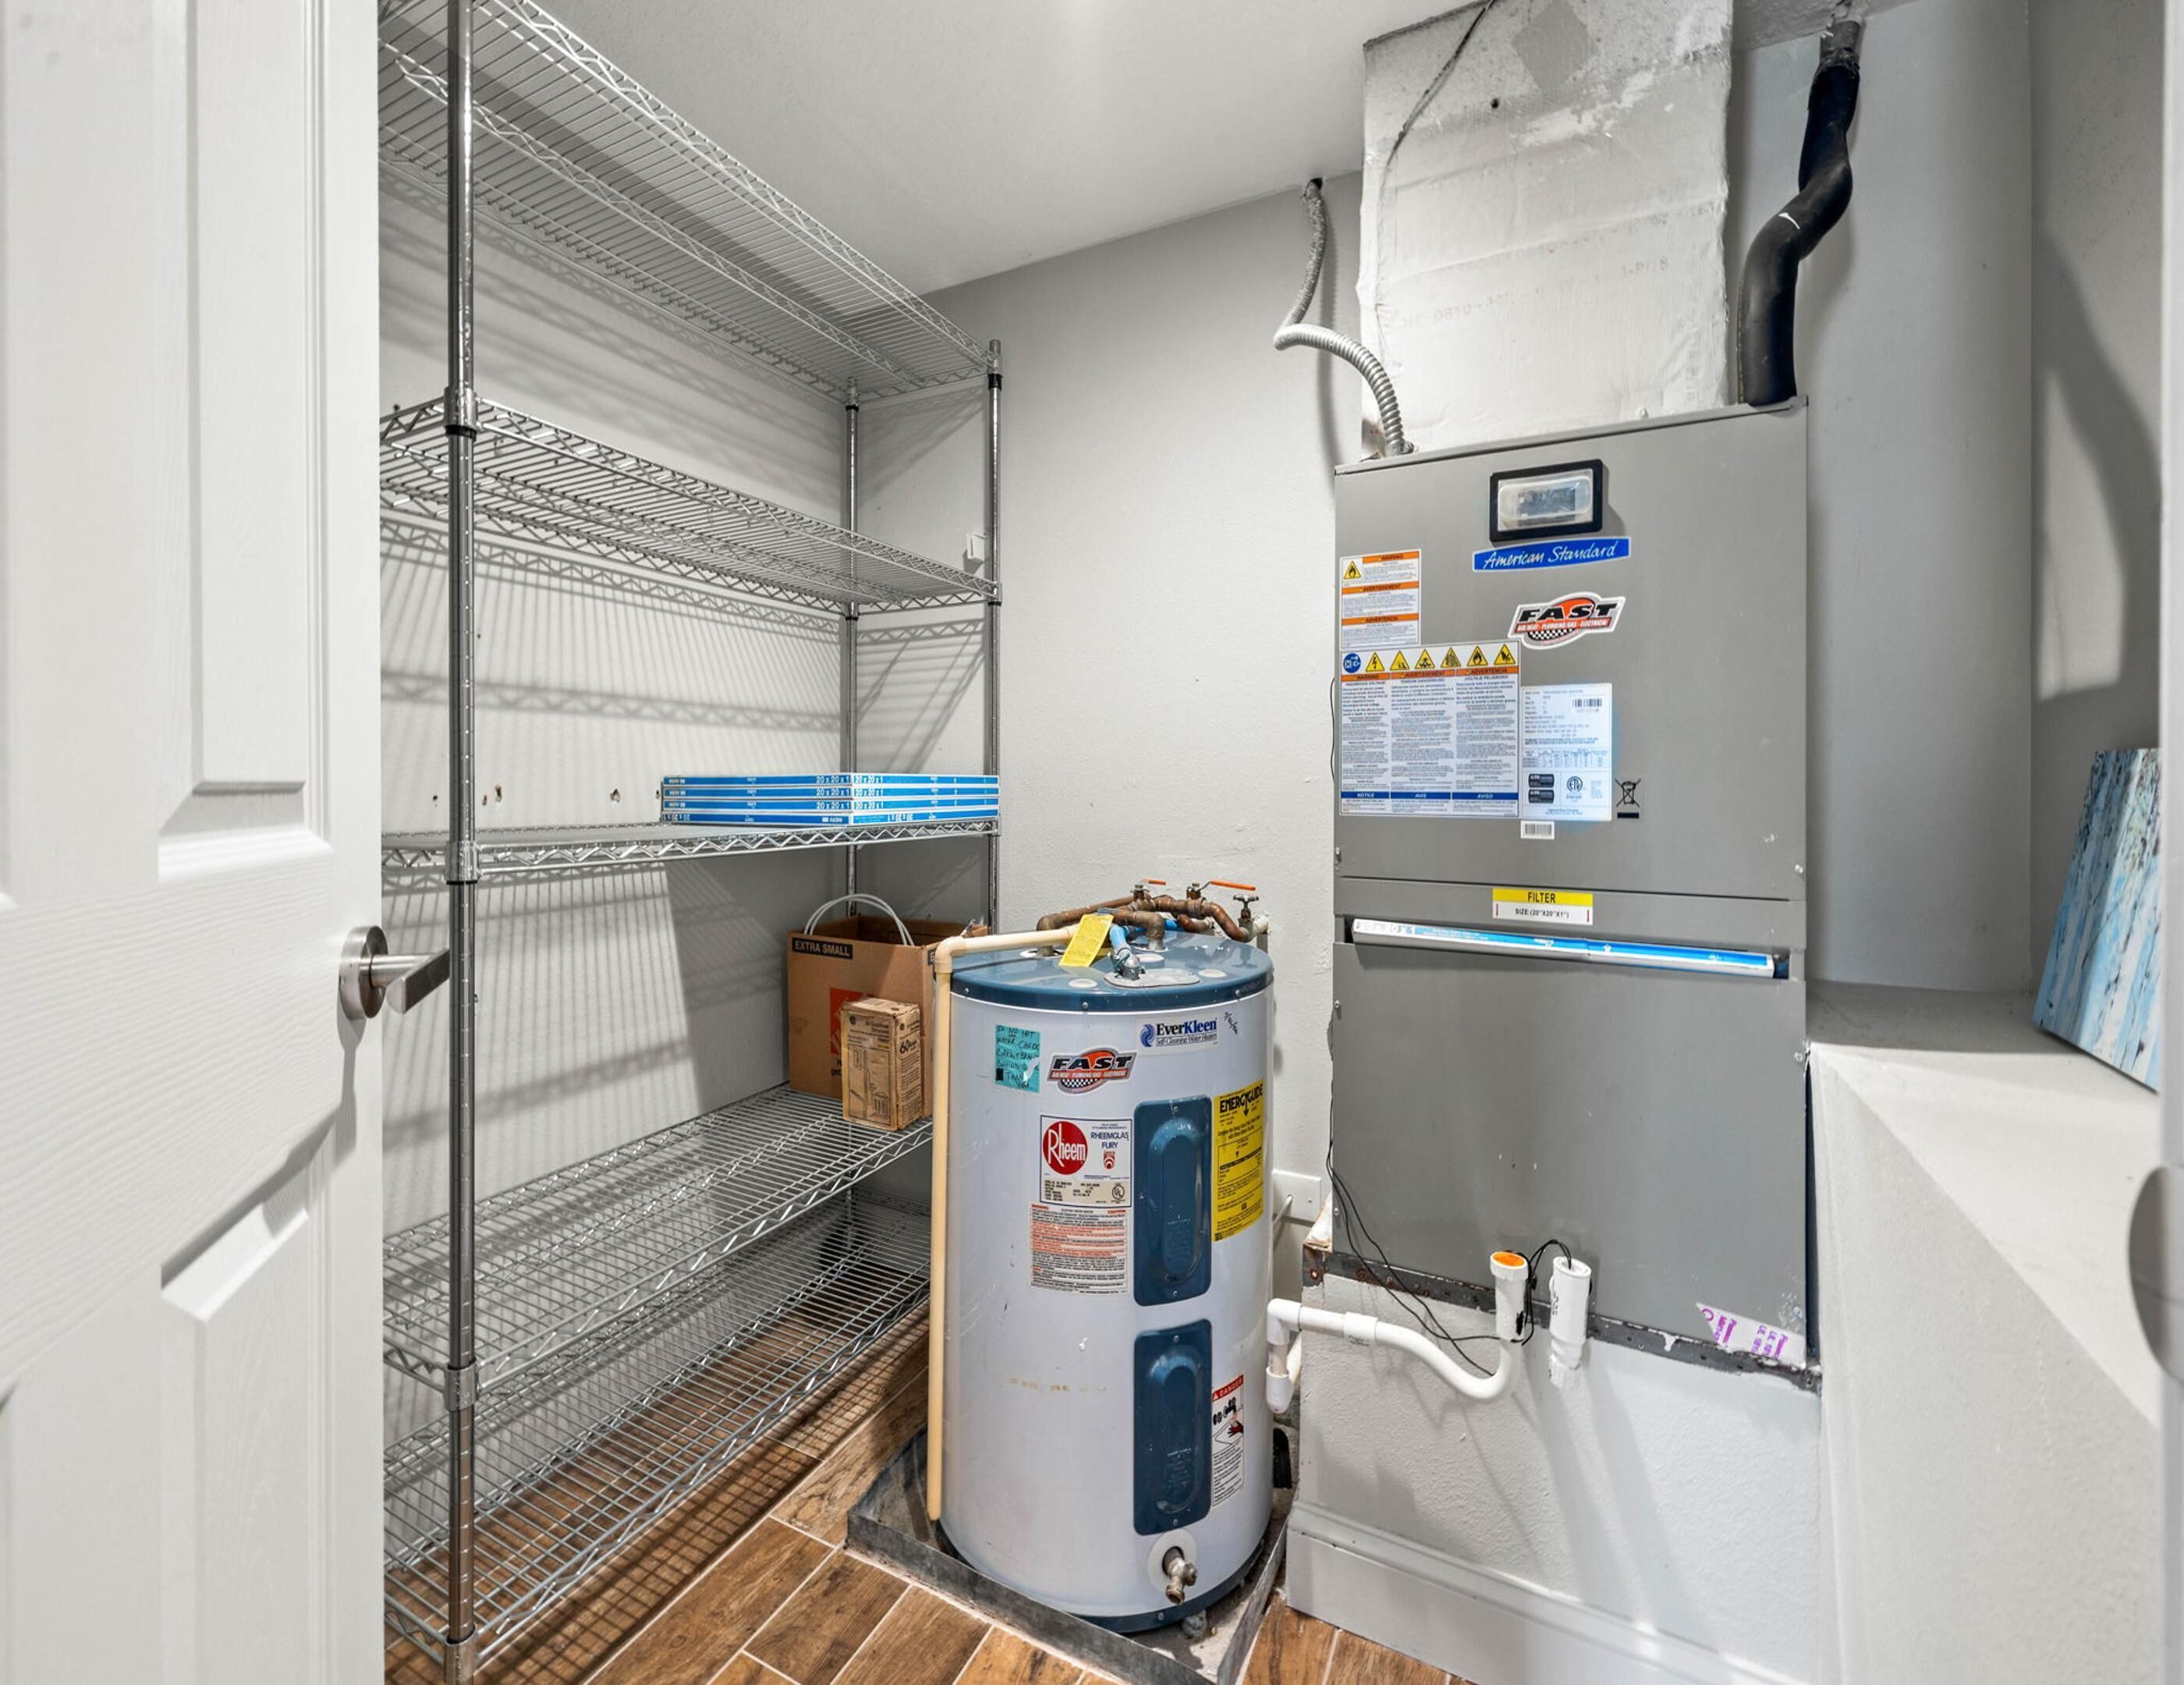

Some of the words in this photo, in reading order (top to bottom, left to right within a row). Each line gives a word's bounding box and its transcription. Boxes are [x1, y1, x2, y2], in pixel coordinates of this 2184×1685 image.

[1482, 551, 1544, 569] American
[1548, 540, 1618, 563] Standard
[1519, 603, 1618, 622] FAST
[1527, 892, 1556, 904] FILTER
[795, 940, 821, 953] EXTRA
[822, 943, 849, 956] SMALL
[1156, 1020, 1217, 1036] EverKleen
[1053, 1056, 1133, 1070] FAST
[1090, 1131, 1129, 1140] RHEEMGLAS
[1048, 1123, 1086, 1168] Rheem
